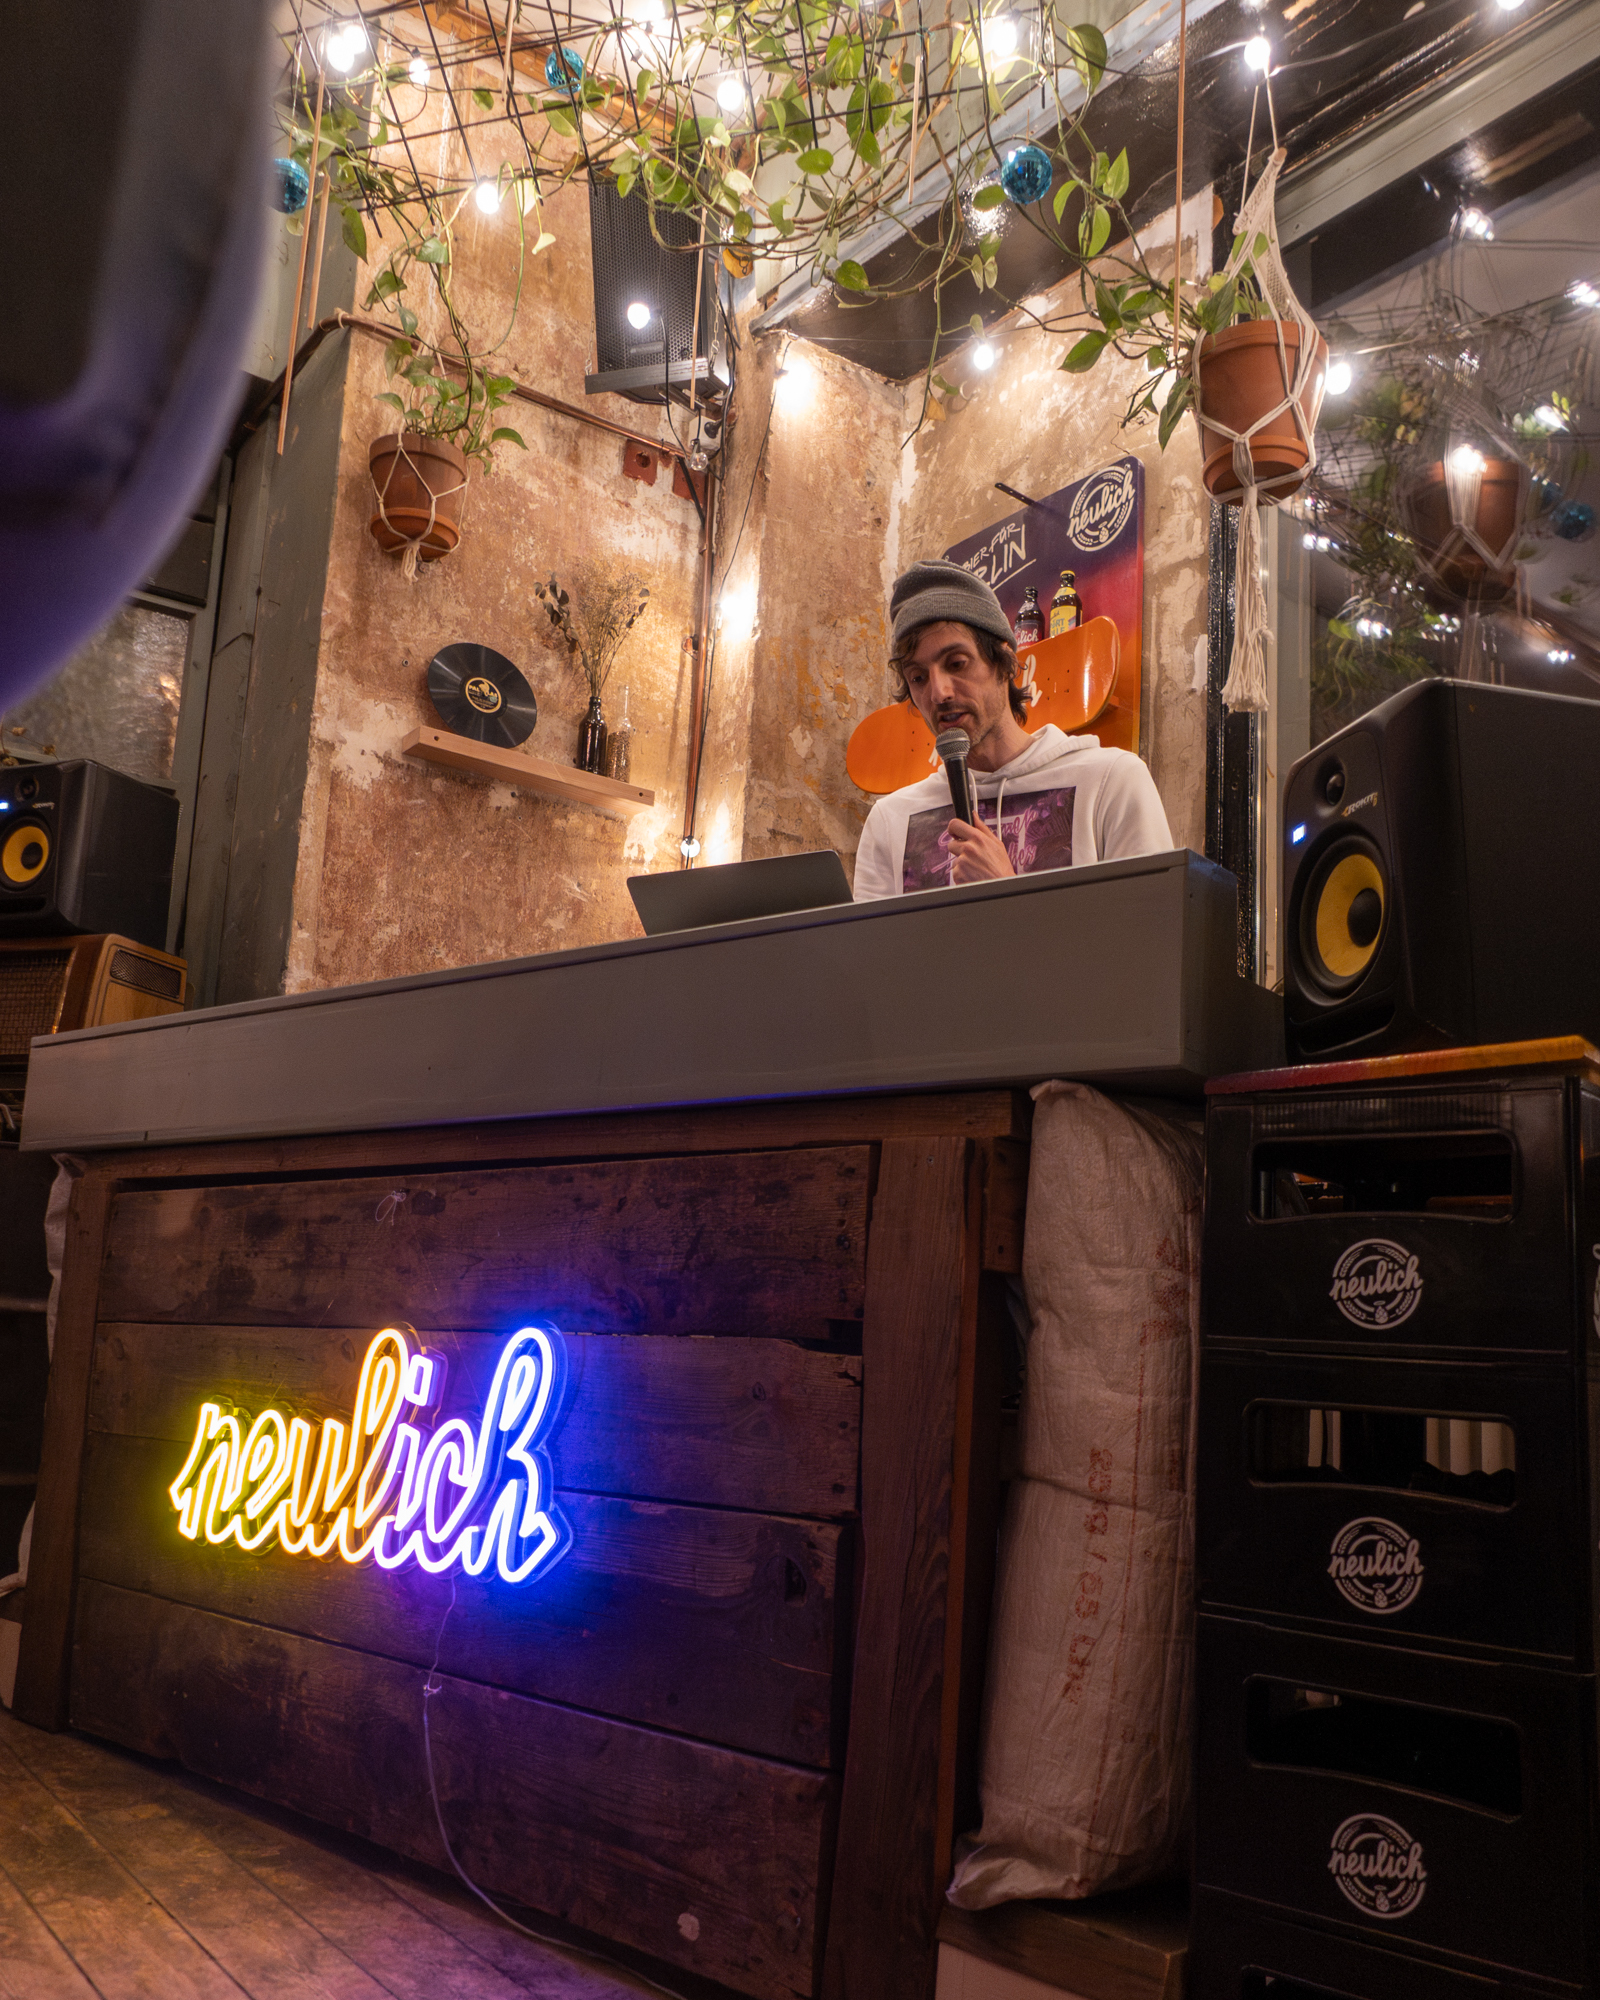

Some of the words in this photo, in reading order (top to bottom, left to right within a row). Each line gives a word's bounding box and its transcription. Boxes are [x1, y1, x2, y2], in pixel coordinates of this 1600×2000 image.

[1066, 470, 1136, 538] neulich
[973, 524, 1026, 586] RLIN
[1328, 1254, 1424, 1301] neulich
[169, 1327, 557, 1584] neulich
[1327, 1538, 1425, 1581] neulich
[1327, 1838, 1428, 1881] neulich
